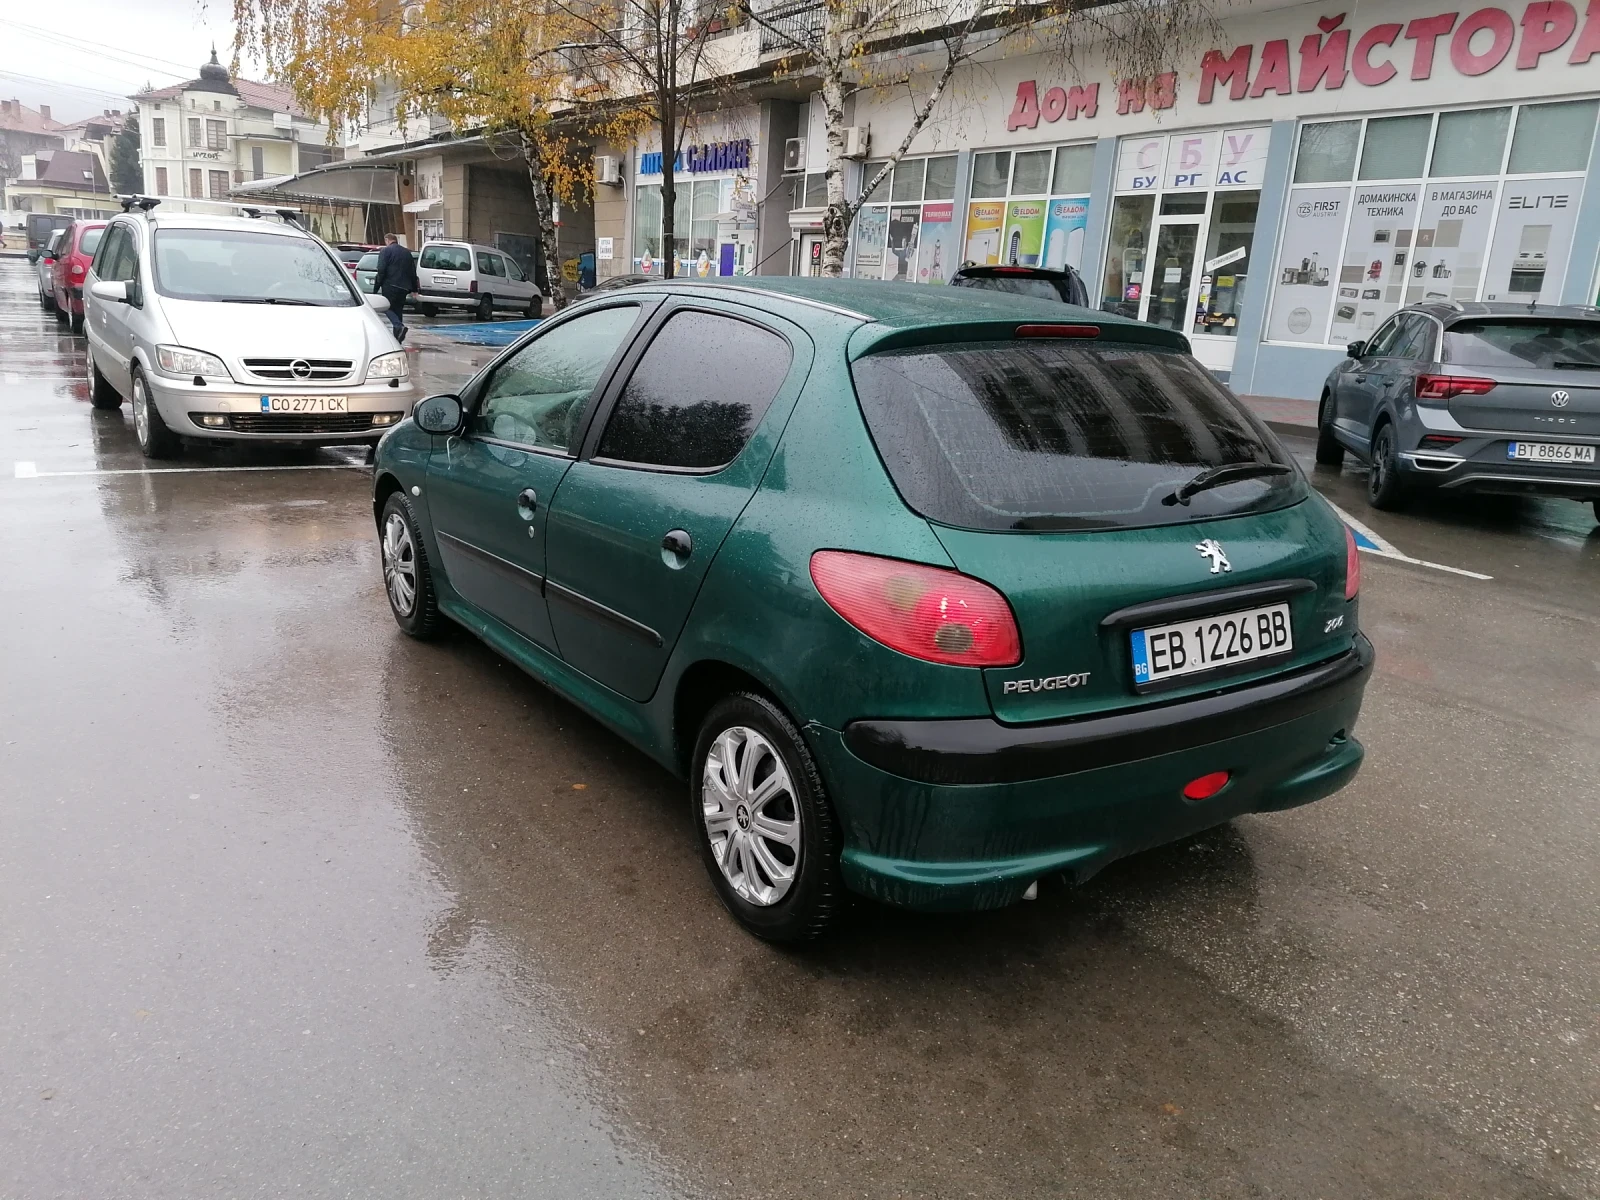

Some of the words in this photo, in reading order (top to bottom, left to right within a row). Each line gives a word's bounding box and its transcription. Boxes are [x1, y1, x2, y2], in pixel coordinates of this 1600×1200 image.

[1116, 71, 1178, 115] на
[1358, 192, 1417, 205] ДОМАКИНСКА
[1431, 191, 1439, 201] В
[1440, 189, 1493, 201] МАГАЗИНА
[1313, 201, 1341, 211] FIRST
[1508, 195, 1569, 209] ELITE
[1298, 206, 1312, 214] TZS
[1366, 207, 1404, 217] ТЕХНИКА
[1441, 205, 1457, 217] ДО
[1457, 204, 1478, 215] ВАС
[271, 398, 290, 411] CO
[292, 398, 324, 411] 2771
[328, 398, 345, 411] CK
[1518, 444, 1537, 457] BT
[1538, 445, 1572, 459] 8866
[1574, 447, 1592, 460] MA
[1149, 630, 1187, 674] EB
[1194, 617, 1253, 664] 1226
[1256, 610, 1288, 651] BB
[1134, 662, 1148, 676] BG
[1003, 672, 1091, 695] PEUGEOT
